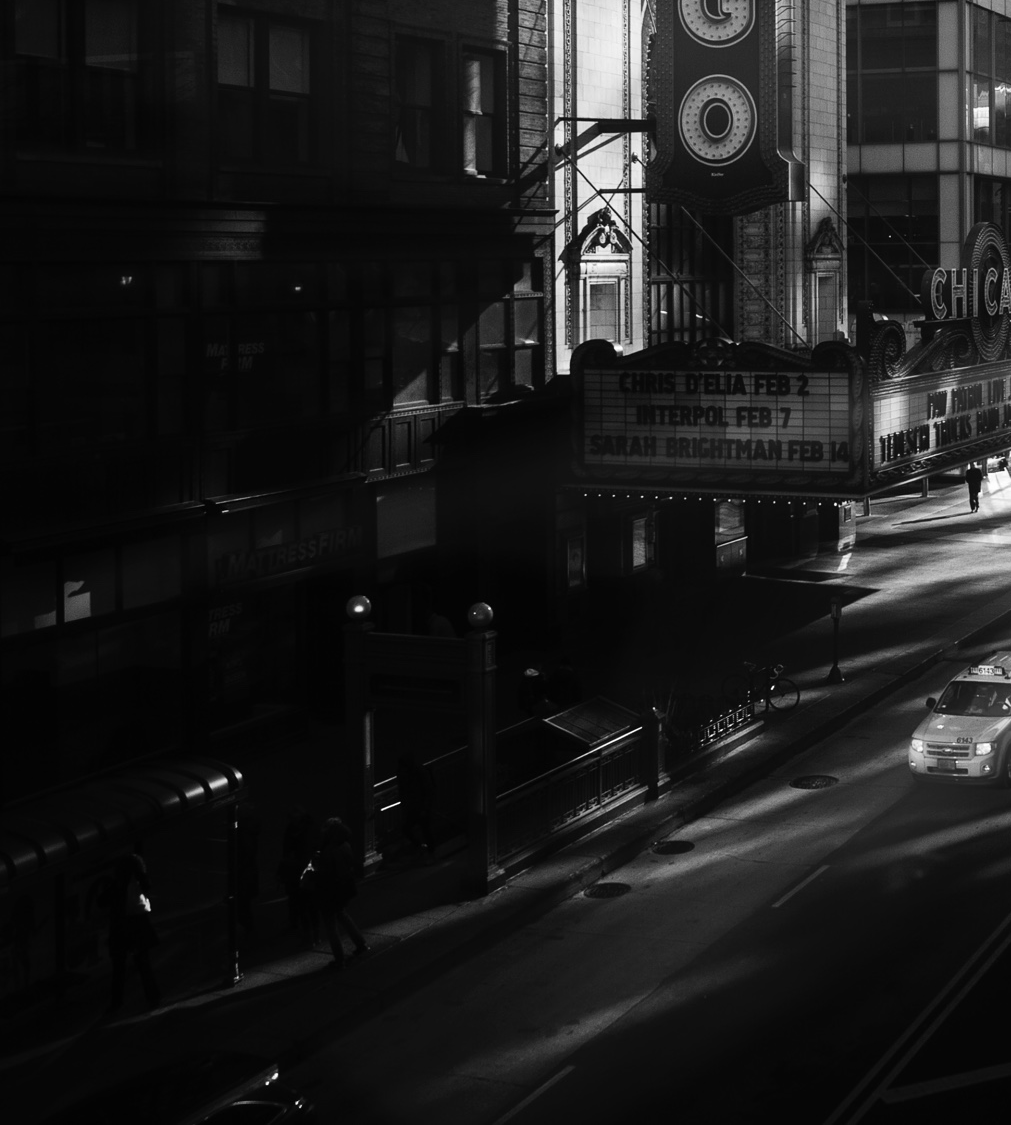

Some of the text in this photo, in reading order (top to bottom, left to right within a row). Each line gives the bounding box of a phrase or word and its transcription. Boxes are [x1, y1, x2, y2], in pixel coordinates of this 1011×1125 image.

[619, 372, 810, 396] CHRIS D'ELIA FEB 2
[636, 404, 791, 428] INTERPOL FEB 7
[590, 435, 849, 463] SARAH BRIGHTMAN FEB 14
[956, 736, 973, 744] 6143
